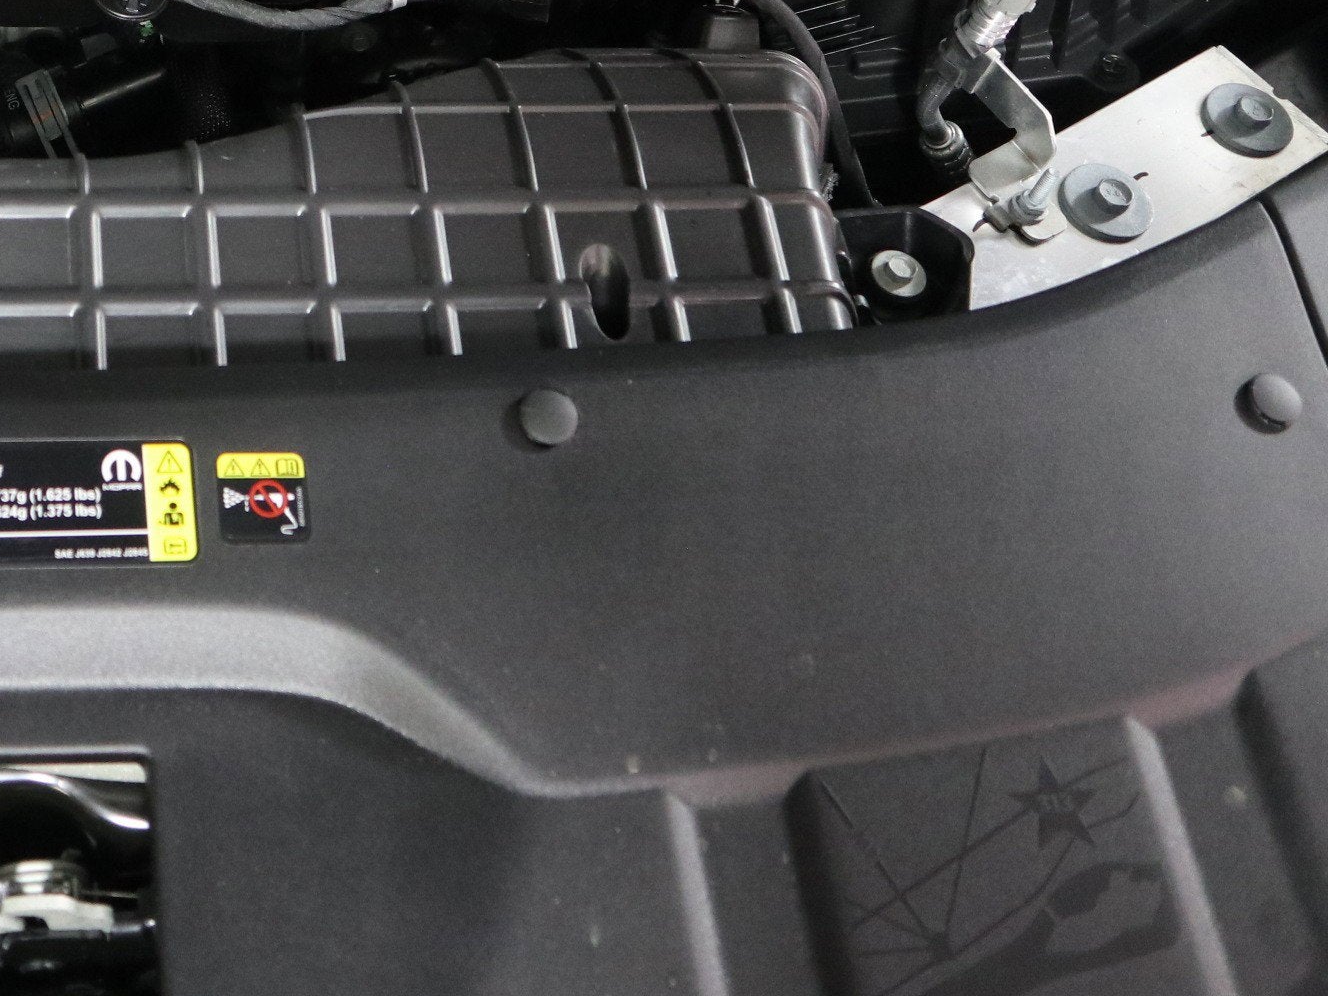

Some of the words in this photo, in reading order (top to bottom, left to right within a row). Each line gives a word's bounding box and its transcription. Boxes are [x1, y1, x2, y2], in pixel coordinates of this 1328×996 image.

[29, 487, 72, 504] (1.625
[74, 487, 101, 503] lbs)
[30, 504, 73, 521] (1.375
[74, 504, 102, 520] lbs)
[54, 548, 74, 559] SAE
